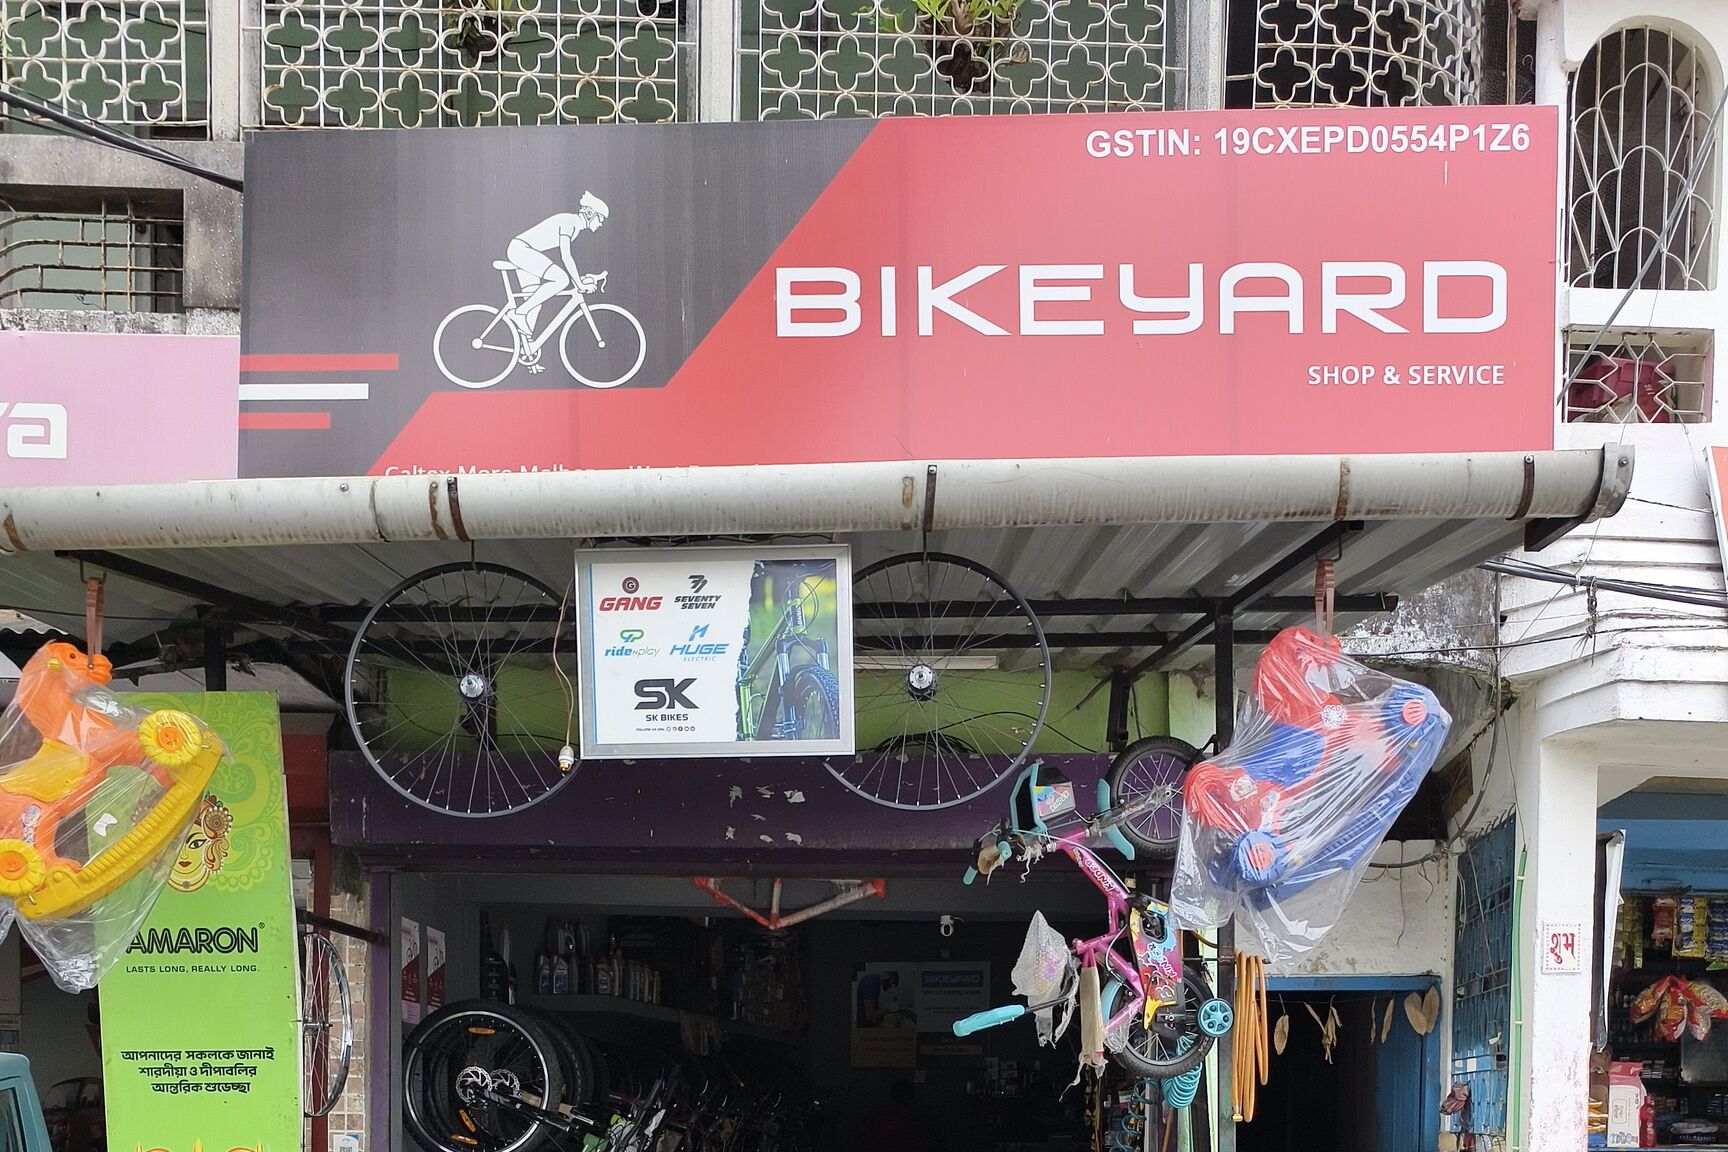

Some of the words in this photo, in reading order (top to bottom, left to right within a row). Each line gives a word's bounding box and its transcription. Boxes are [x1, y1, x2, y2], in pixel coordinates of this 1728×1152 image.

[1086, 128, 1202, 158] GSTIN:
[1212, 122, 1532, 157] 19CXEPD0554P1Z6
[774, 259, 1509, 339] BIKEYARD
[1307, 364, 1376, 386] SHOP
[1383, 364, 1401, 385] &
[1407, 363, 1506, 386] SERVICE
[0, 402, 68, 459] a
[599, 596, 663, 611] GANG
[674, 595, 722, 603] SEVENTY
[669, 643, 730, 655] HUGE
[634, 678, 700, 710] SK
[660, 713, 689, 721] BIKES
[1085, 857, 1116, 893] KINDER
[126, 927, 259, 954] AMARON
[1550, 932, 1576, 964] शुभ
[126, 965, 156, 973] LASTS
[159, 965, 189, 973] LONG,
[191, 965, 227, 973] REALLY
[121, 1050, 182, 1061] আপনাদের
[185, 1050, 235, 1060] সকলকে
[236, 1046, 275, 1060] জানাই
[138, 1063, 187, 1078] শারদীয়া
[189, 1067, 198, 1076] ও
[200, 1063, 257, 1077] দীপাবলির
[151, 1079, 203, 1095] আন্তরিক
[204, 1082, 251, 1094] শুভেচ্ছা
